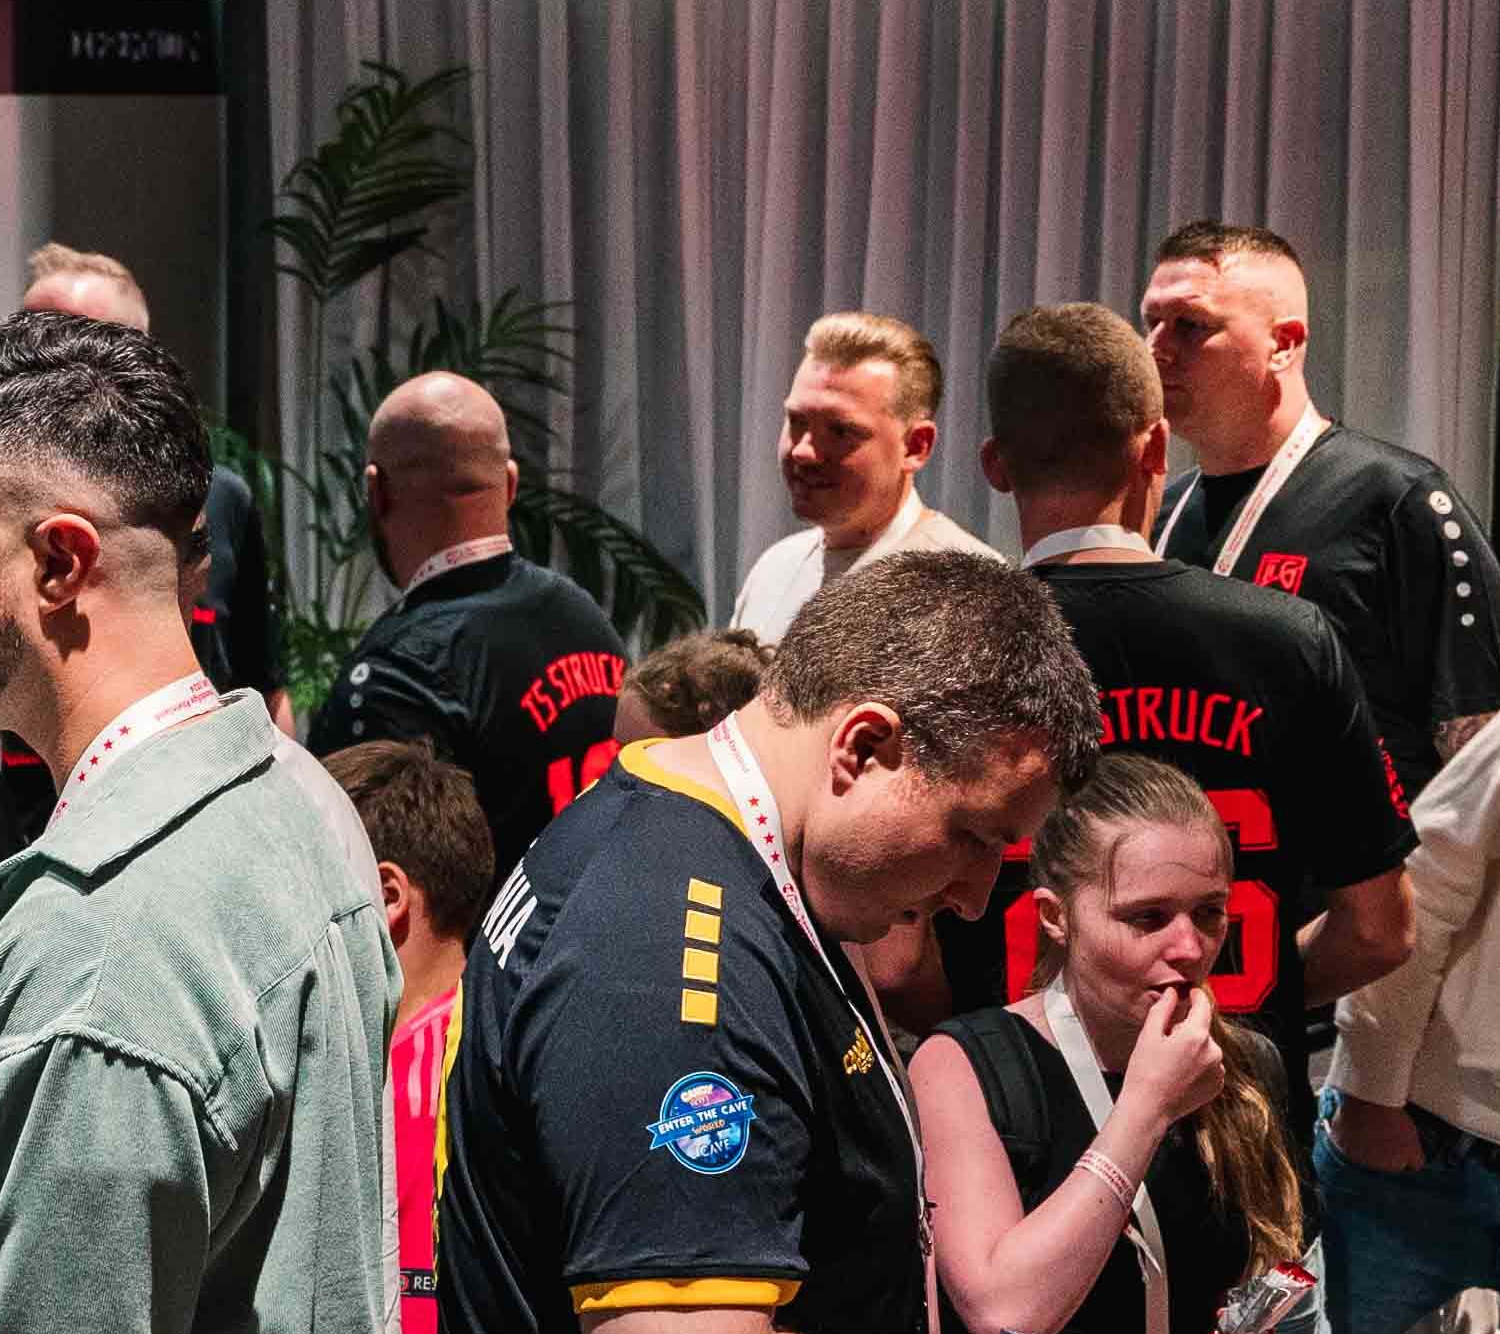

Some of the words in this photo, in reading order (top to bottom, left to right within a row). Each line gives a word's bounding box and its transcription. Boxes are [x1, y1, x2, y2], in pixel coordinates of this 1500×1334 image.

[658, 1115, 694, 1135] ENTER
[696, 1108, 718, 1122] THE
[721, 1100, 748, 1115] CAVE
